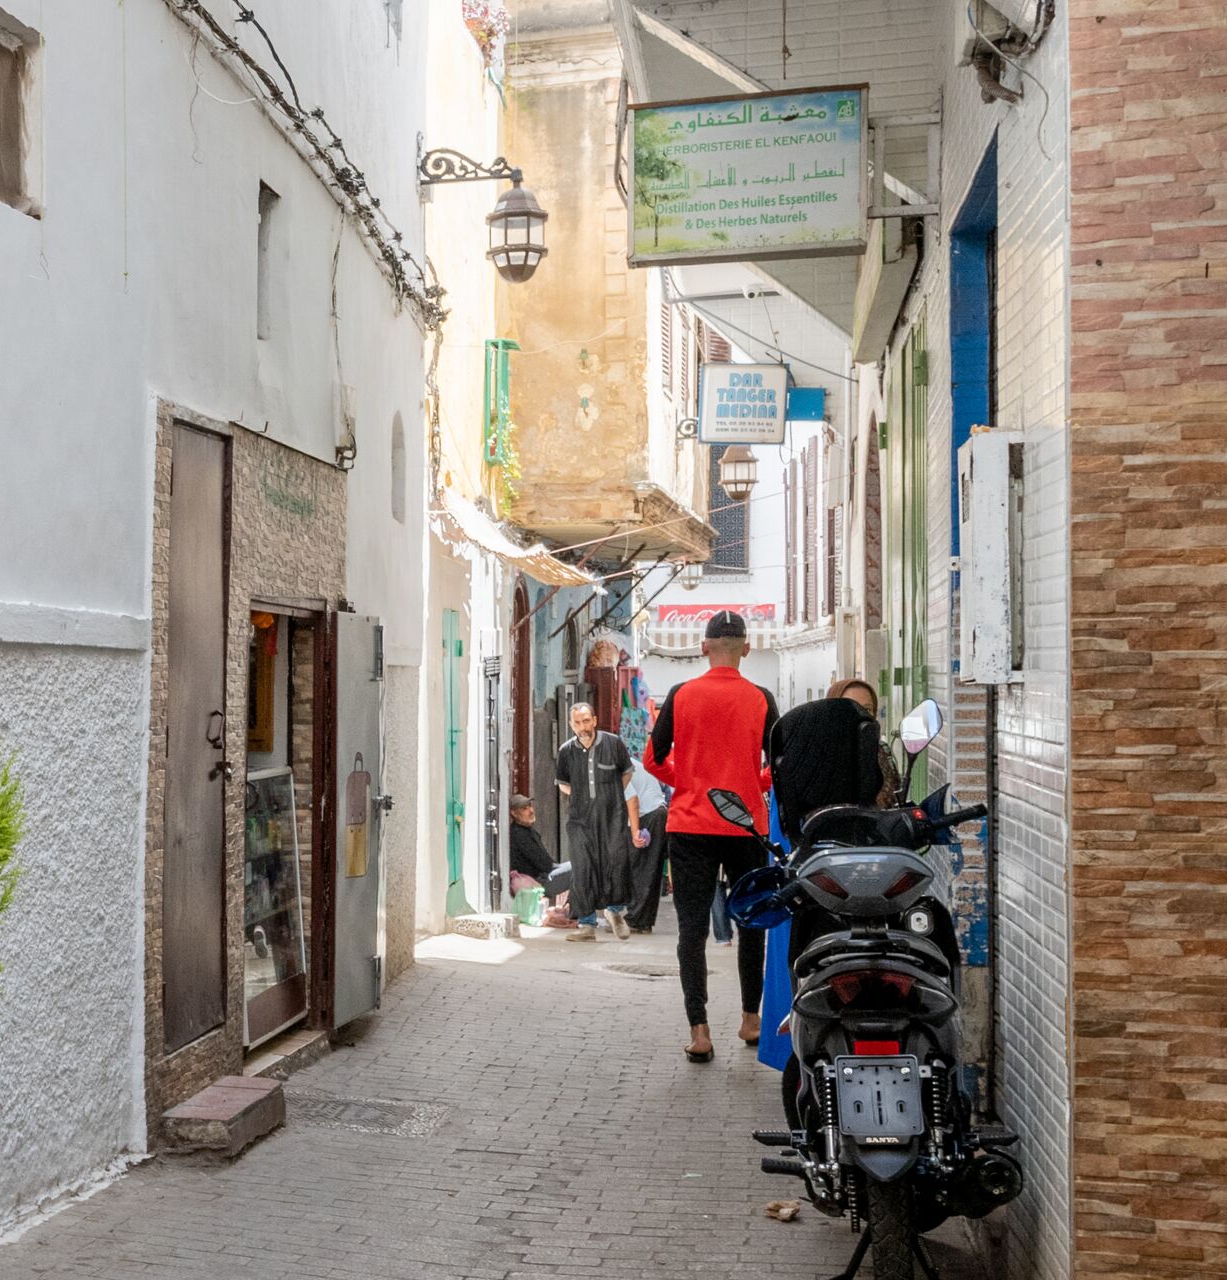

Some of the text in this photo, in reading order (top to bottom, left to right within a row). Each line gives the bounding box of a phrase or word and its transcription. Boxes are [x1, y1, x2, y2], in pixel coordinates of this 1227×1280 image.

[667, 104, 752, 134] الكنفاوي
[659, 132, 837, 156] HERBORISTERIE EL KENFAOUI
[656, 200, 716, 214] Distillation
[719, 198, 739, 210] Des
[742, 194, 776, 208] Huiles
[685, 210, 808, 230] & Des Herbes Naturels
[729, 373, 763, 387] DAR
